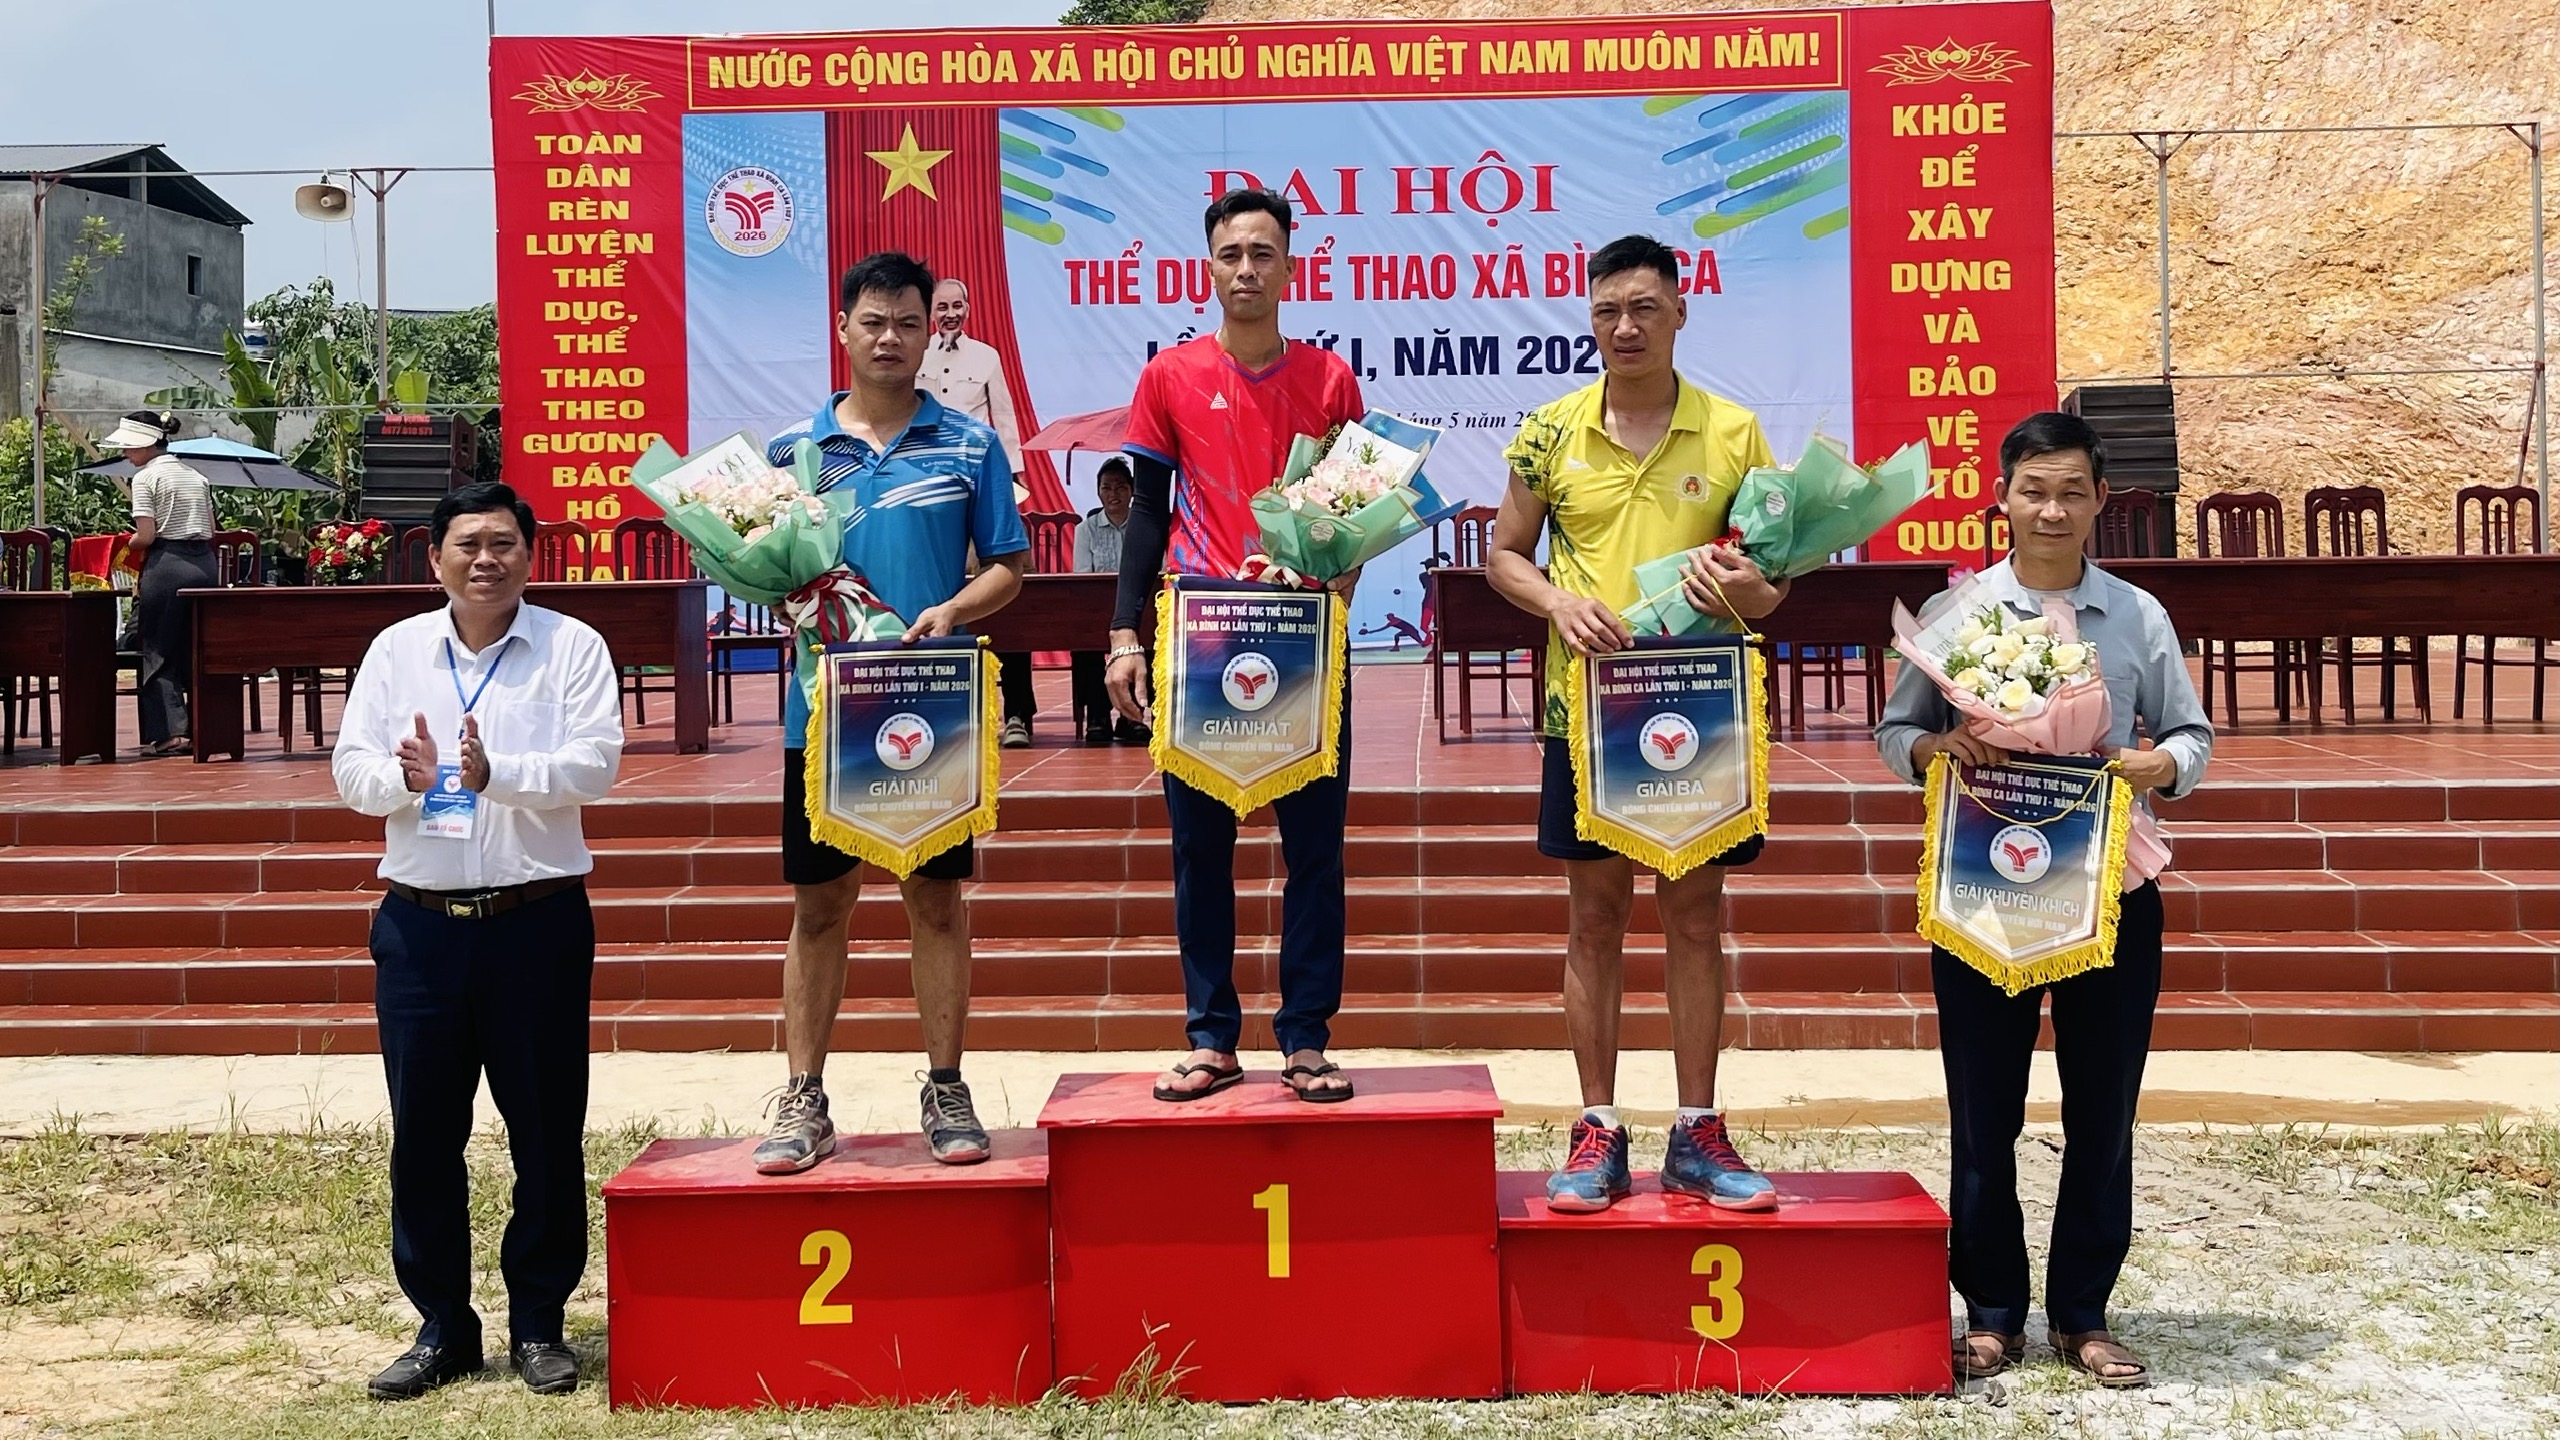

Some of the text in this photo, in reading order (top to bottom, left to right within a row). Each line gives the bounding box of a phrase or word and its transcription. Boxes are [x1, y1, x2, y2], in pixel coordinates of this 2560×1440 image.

[709, 27, 1820, 92] NƯỚC CỘNG HÒA XÃ HỘI CHỦ NGHĨA VIỆT NAM MUÔN NĂM!
[1892, 93, 2006, 137] KHỎE
[534, 131, 642, 155] TOÀN
[546, 165, 630, 188] DÂN
[1920, 144, 1979, 188] ĐỂ
[1390, 150, 1560, 228] HỘI
[548, 198, 629, 220] RÈN
[1907, 202, 1994, 241] XÂY
[526, 230, 654, 258] LUYỆN
[734, 231, 766, 241] 2026
[552, 259, 628, 288] THỂ
[1064, 235, 1722, 314] THỂ DỤ HỂ THAO XÃ BÌ CA
[1891, 258, 2012, 300] DỰNG
[544, 300, 638, 325] DỤC,
[1923, 307, 1980, 344] VÀ
[554, 324, 629, 354] THỂ
[1351, 338, 1377, 382] I,
[1394, 328, 1500, 376] NĂM
[1516, 336, 1606, 374] 202
[540, 368, 645, 388] THAO
[1909, 355, 1996, 396] BẢO
[541, 400, 645, 420] THEO
[1449, 411, 1460, 428] 5
[1466, 412, 1506, 428] năm
[1926, 409, 1980, 452] VỆ
[552, 462, 633, 487] BÁC
[1930, 456, 1982, 499] TỔ
[567, 493, 621, 520] HỒ
[1898, 510, 2010, 555] QUỐC
[1282, 606, 1304, 618] THAO
[1220, 622, 1230, 631] CA
[1298, 624, 1316, 634] 2026
[935, 665, 956, 676] THAO
[1696, 664, 1718, 674] THAO
[874, 683, 884, 692] CA
[951, 681, 970, 691] 2026
[1634, 683, 1644, 693] CA
[1714, 679, 1732, 689] 2026
[1203, 716, 1238, 736] GIẢI
[869, 776, 905, 796] GIẢI
[1636, 777, 1704, 798] GIẢI BA
[1994, 789, 2004, 800] CA
[2061, 780, 2082, 794] THAO
[1954, 882, 1981, 900] GIẢI
[1254, 1184, 1290, 1278] 1
[800, 1230, 853, 1325] 2
[1692, 1245, 1744, 1341] 3
